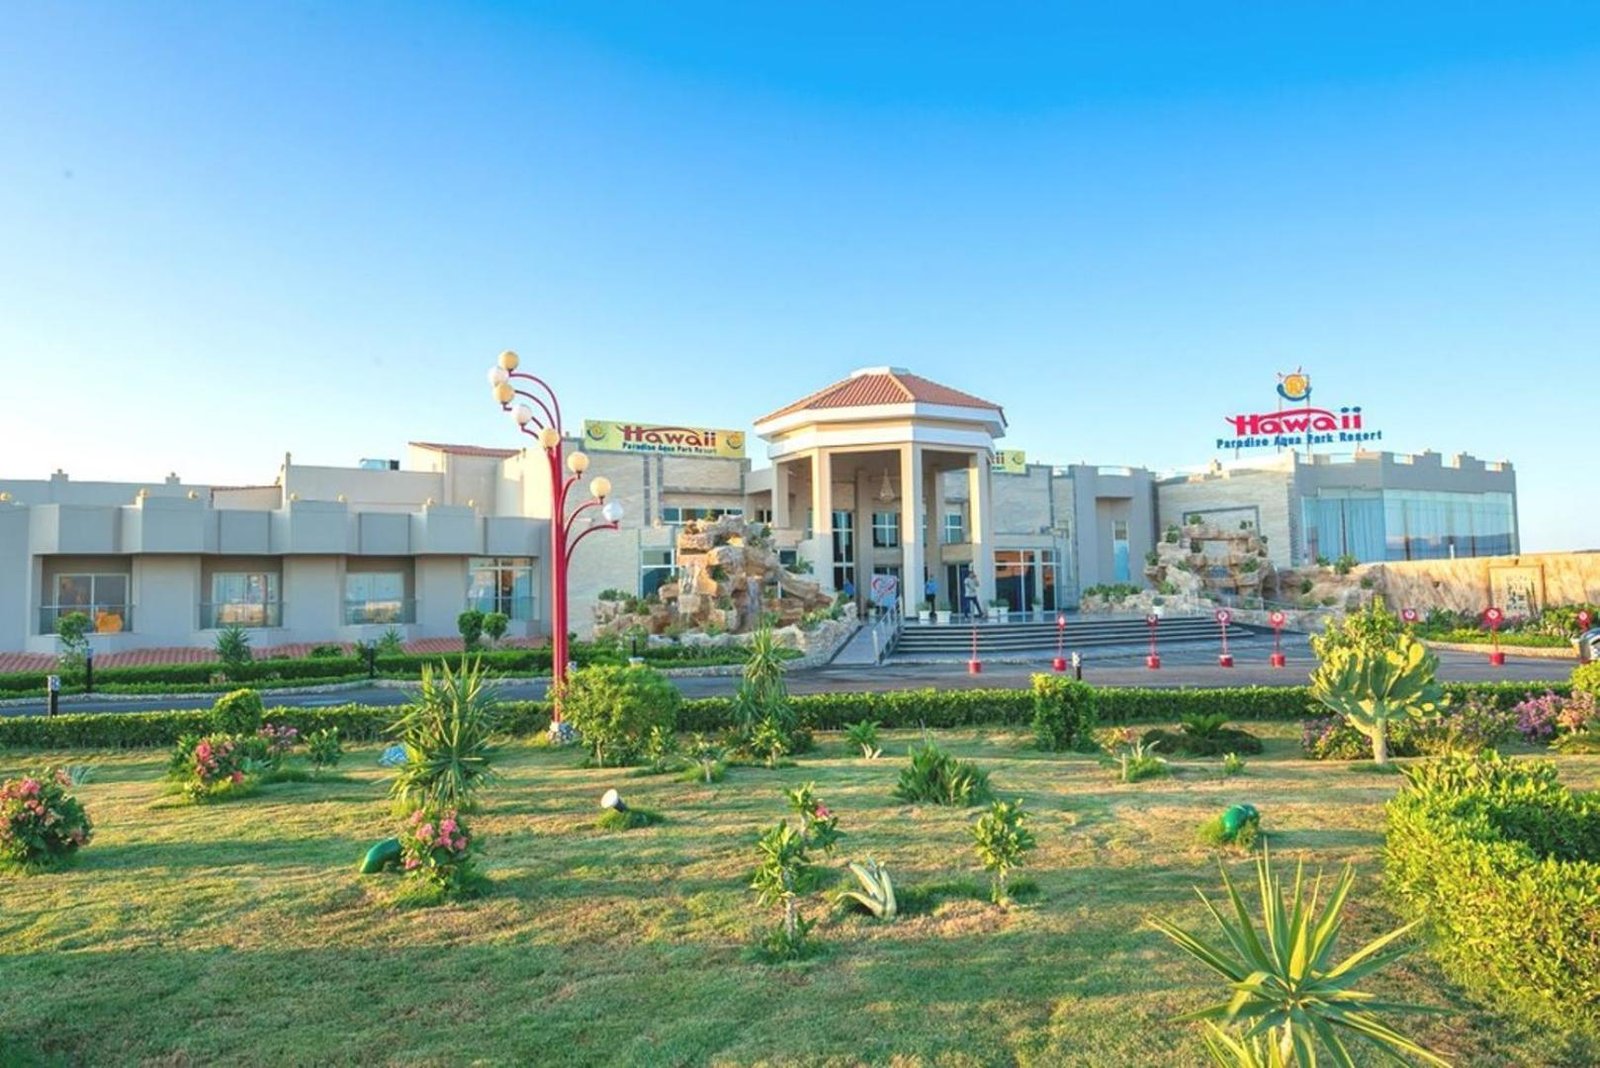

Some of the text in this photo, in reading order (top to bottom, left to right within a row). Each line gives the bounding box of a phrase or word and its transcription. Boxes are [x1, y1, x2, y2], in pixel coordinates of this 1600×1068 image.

[1225, 407, 1361, 436] Hawaii
[617, 425, 717, 446] Hawaii
[1216, 430, 1382, 449] Paradise Aqua Park Resort
[622, 442, 656, 451] Paradise
[658, 444, 675, 452] Aqua
[677, 445, 692, 453] Park
